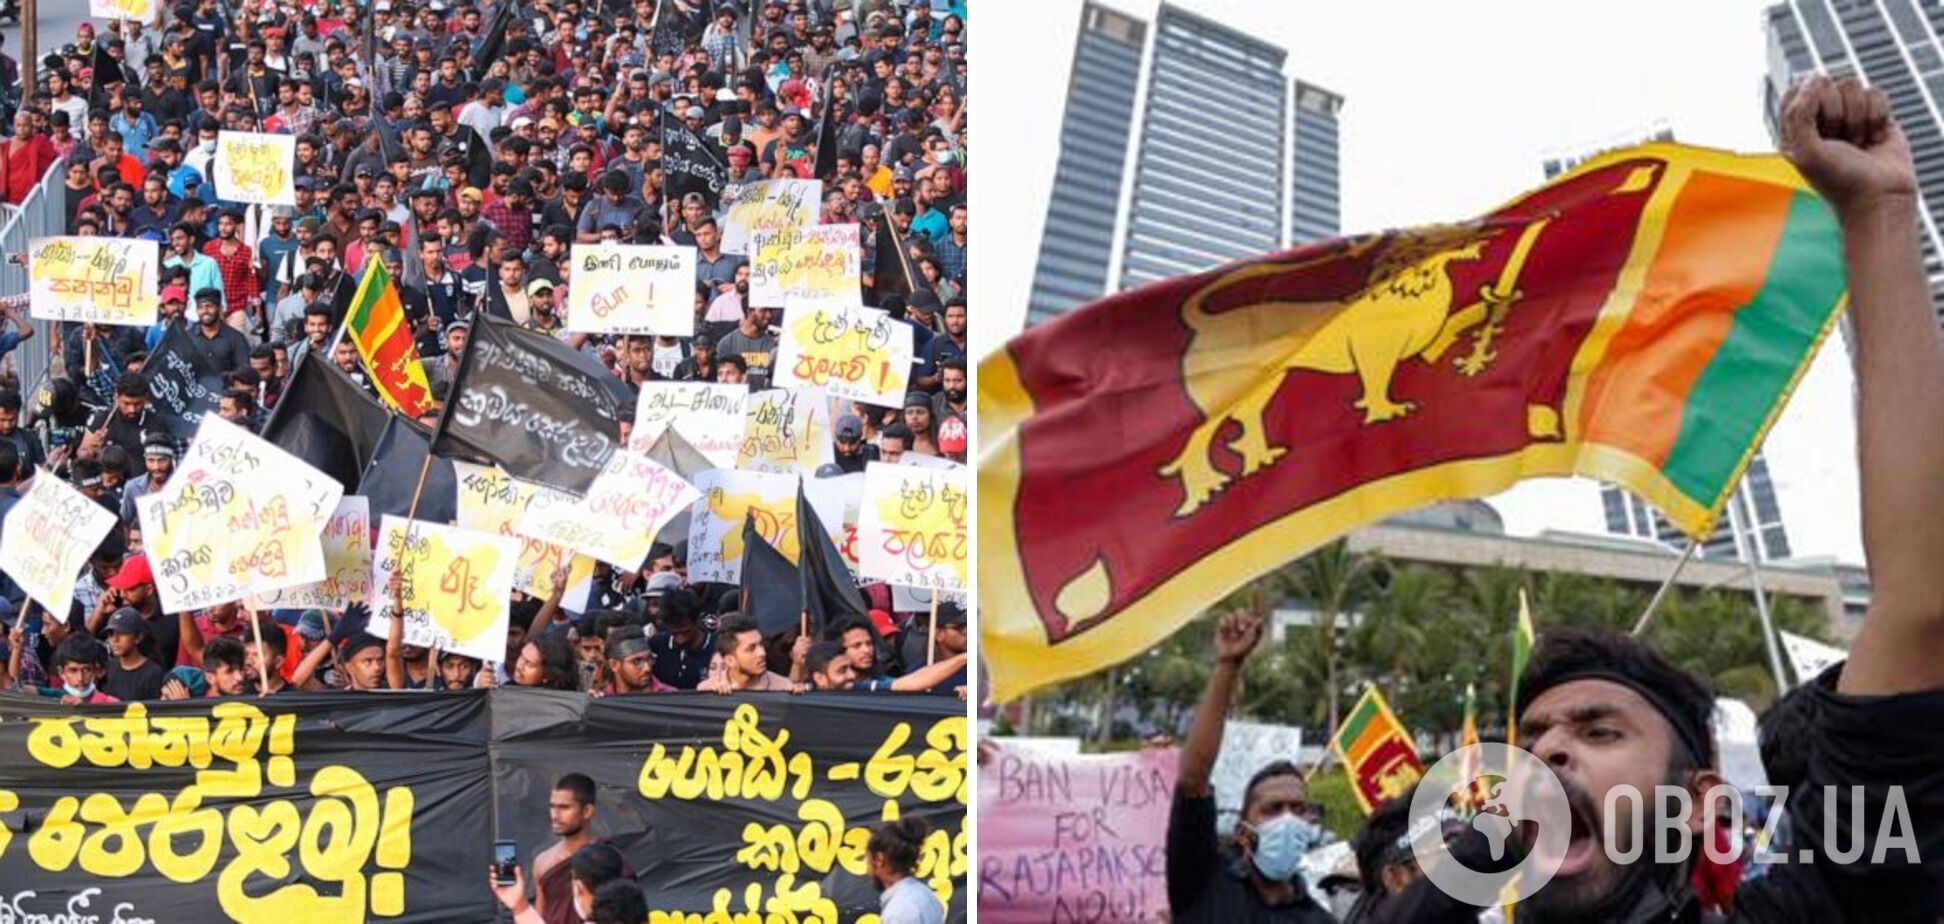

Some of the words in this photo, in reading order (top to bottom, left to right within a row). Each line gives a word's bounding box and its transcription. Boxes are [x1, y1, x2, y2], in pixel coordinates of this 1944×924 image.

[1000, 755, 1072, 805] BAN
[1100, 764, 1170, 809] VISA
[1054, 805, 1121, 849] FOR
